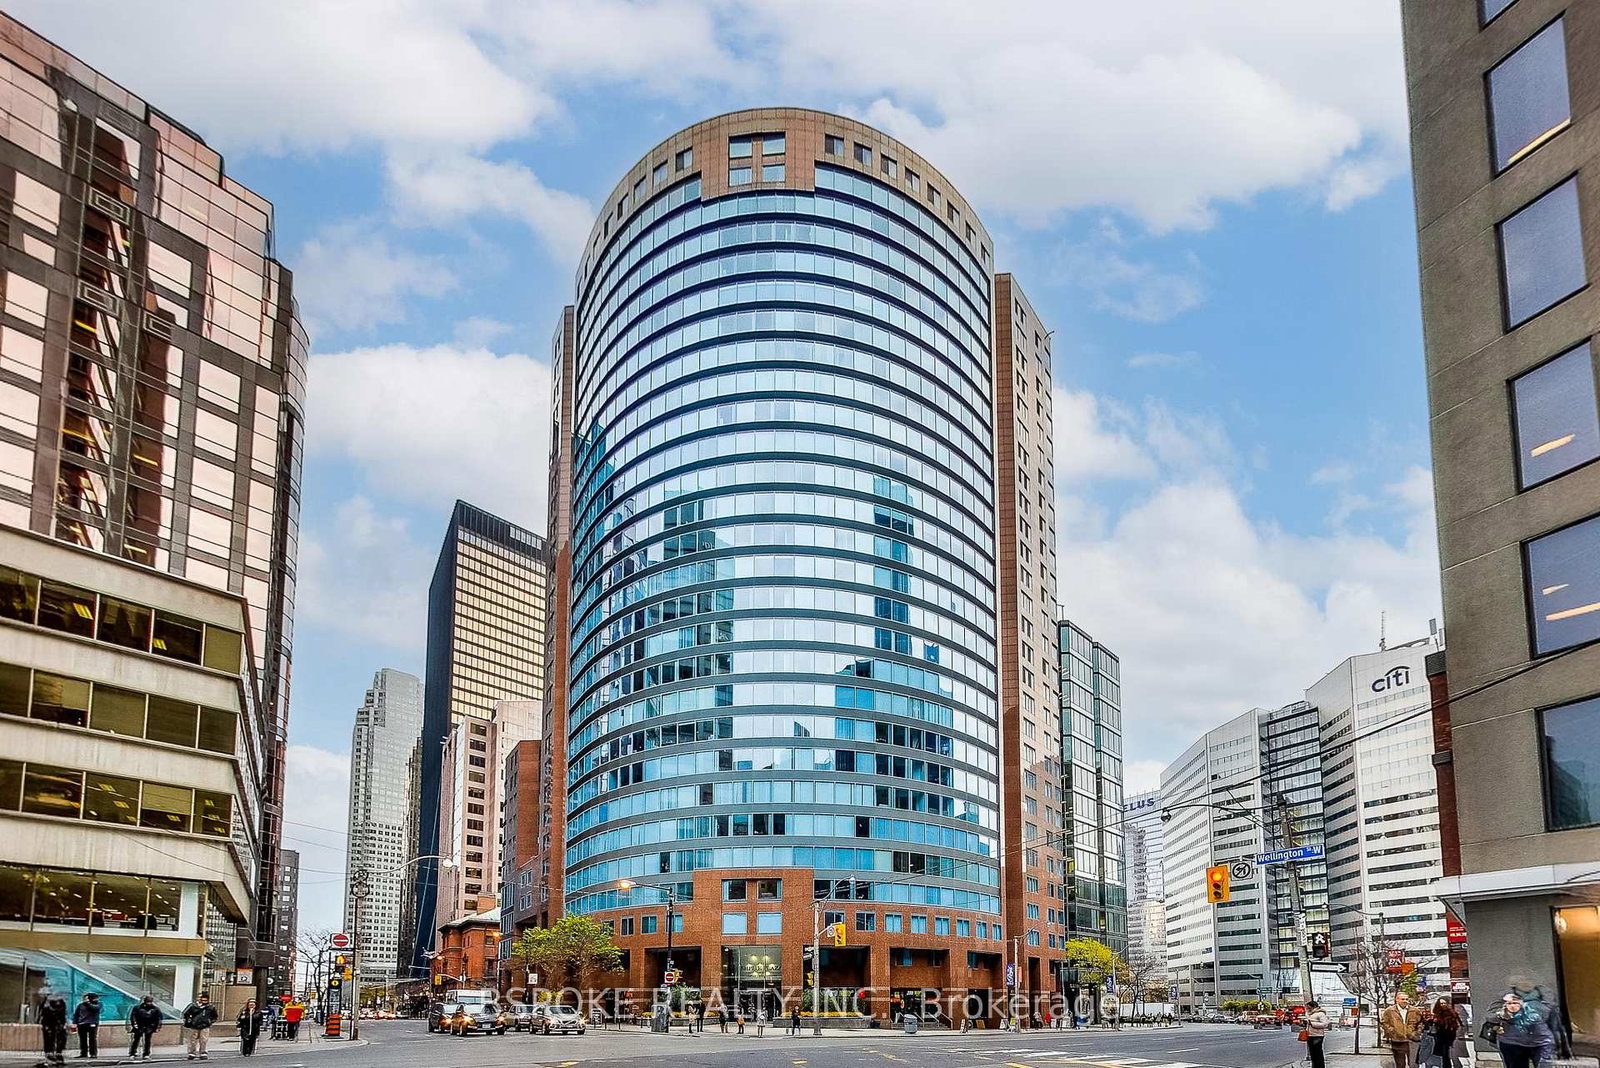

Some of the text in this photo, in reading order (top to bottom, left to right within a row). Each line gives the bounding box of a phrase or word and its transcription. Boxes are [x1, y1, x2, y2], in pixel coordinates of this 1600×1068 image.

[1371, 666, 1410, 693] citi
[1123, 797, 1155, 812] ELUS
[1257, 849, 1304, 863] Wellington
[1313, 845, 1322, 854] W
